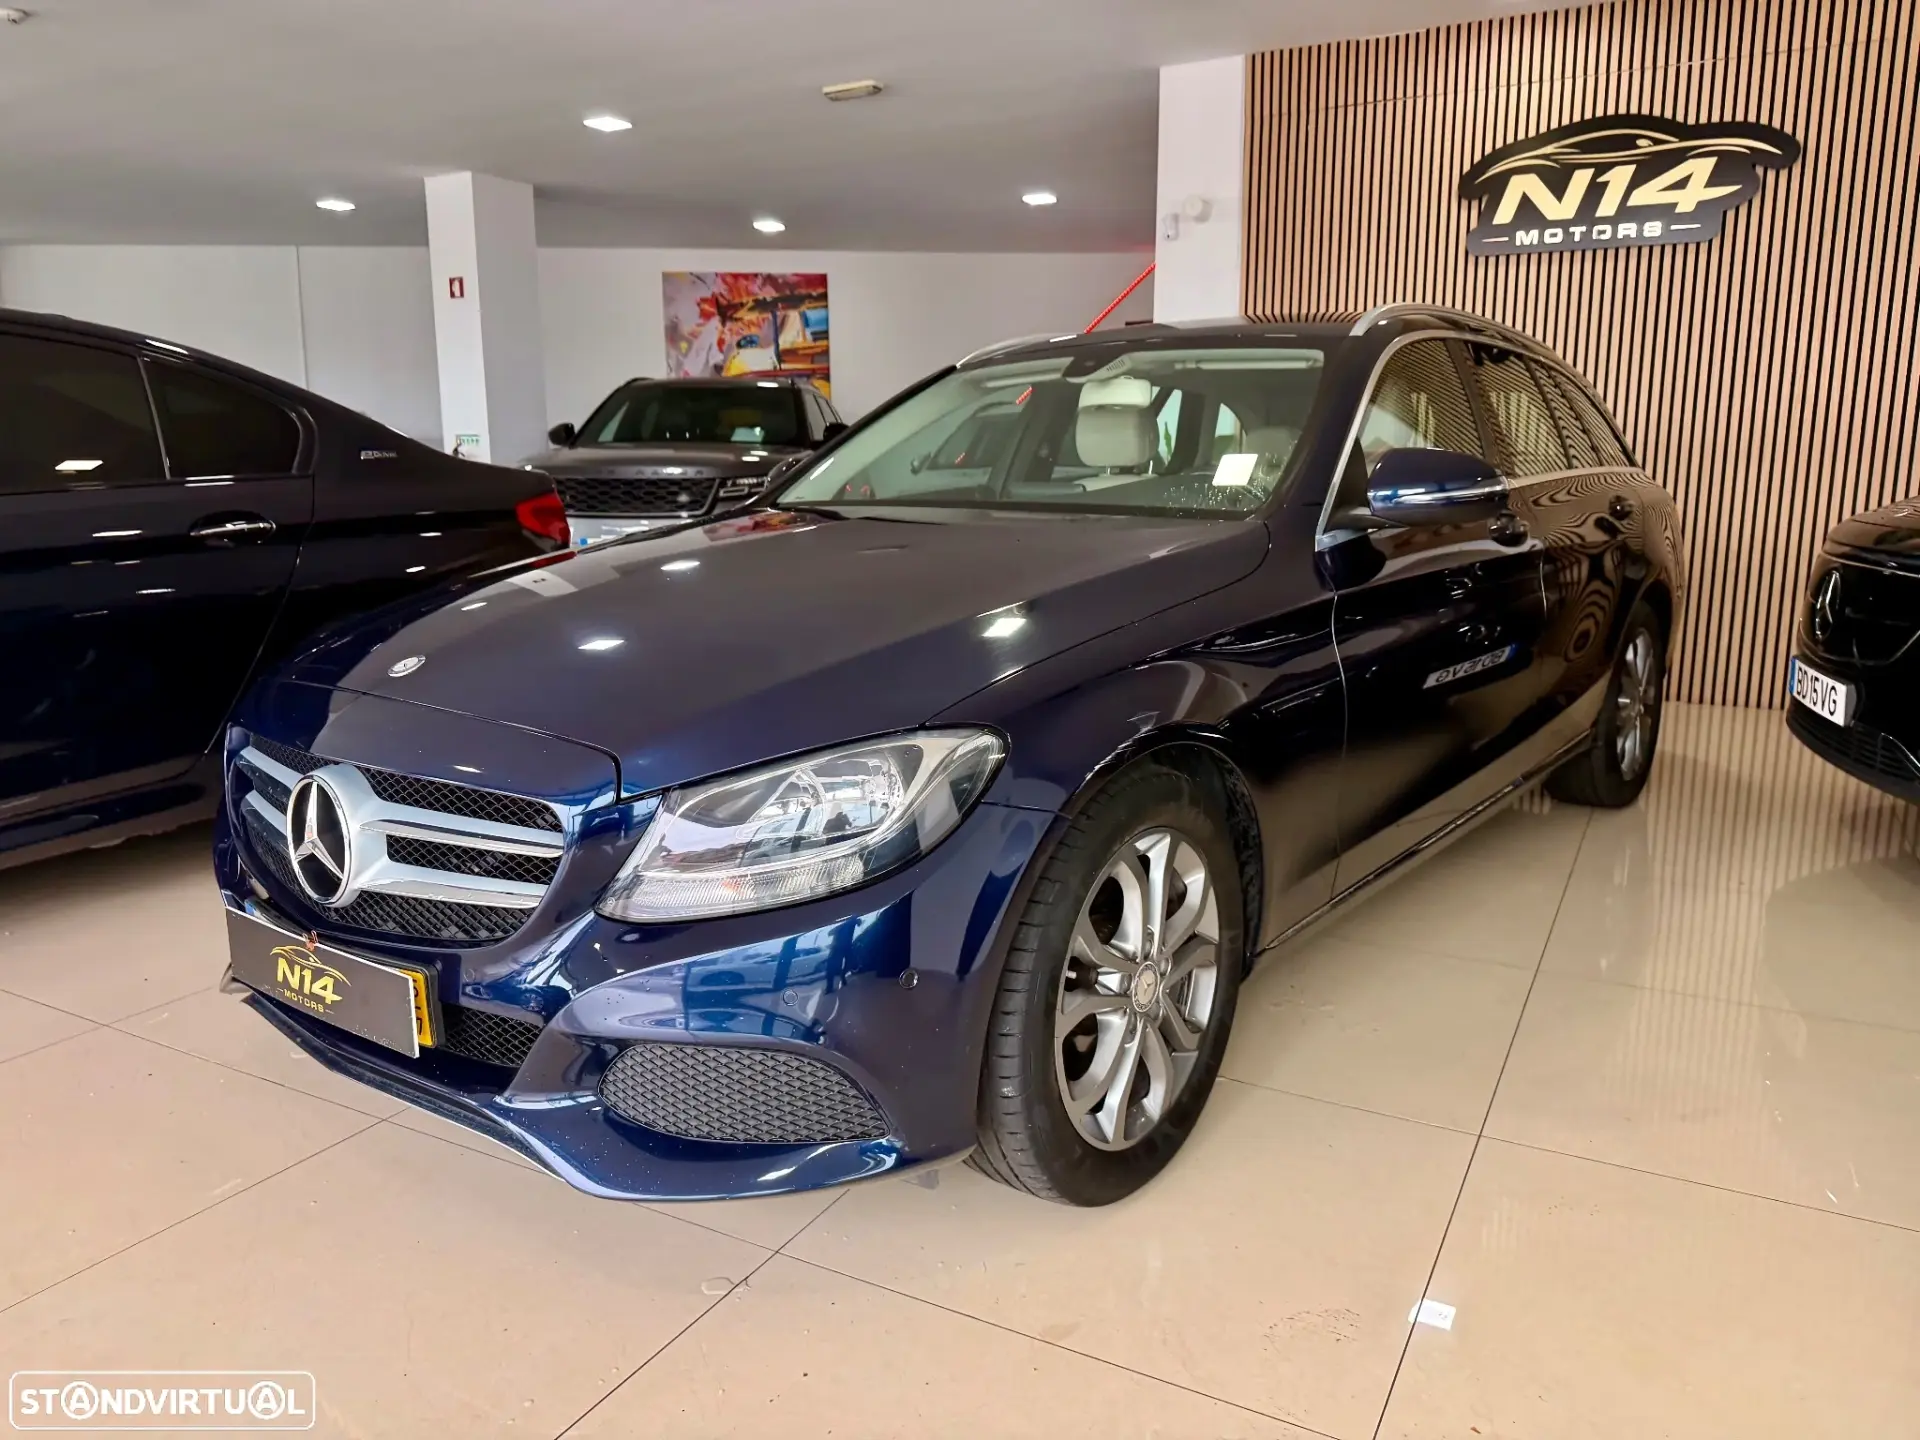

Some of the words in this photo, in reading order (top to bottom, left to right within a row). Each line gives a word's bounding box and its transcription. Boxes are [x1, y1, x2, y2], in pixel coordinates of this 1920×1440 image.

[1492, 156, 1742, 225] N14
[1515, 221, 1662, 246] MOTORS
[277, 956, 343, 1005] N14
[283, 988, 325, 1013] MOTORS
